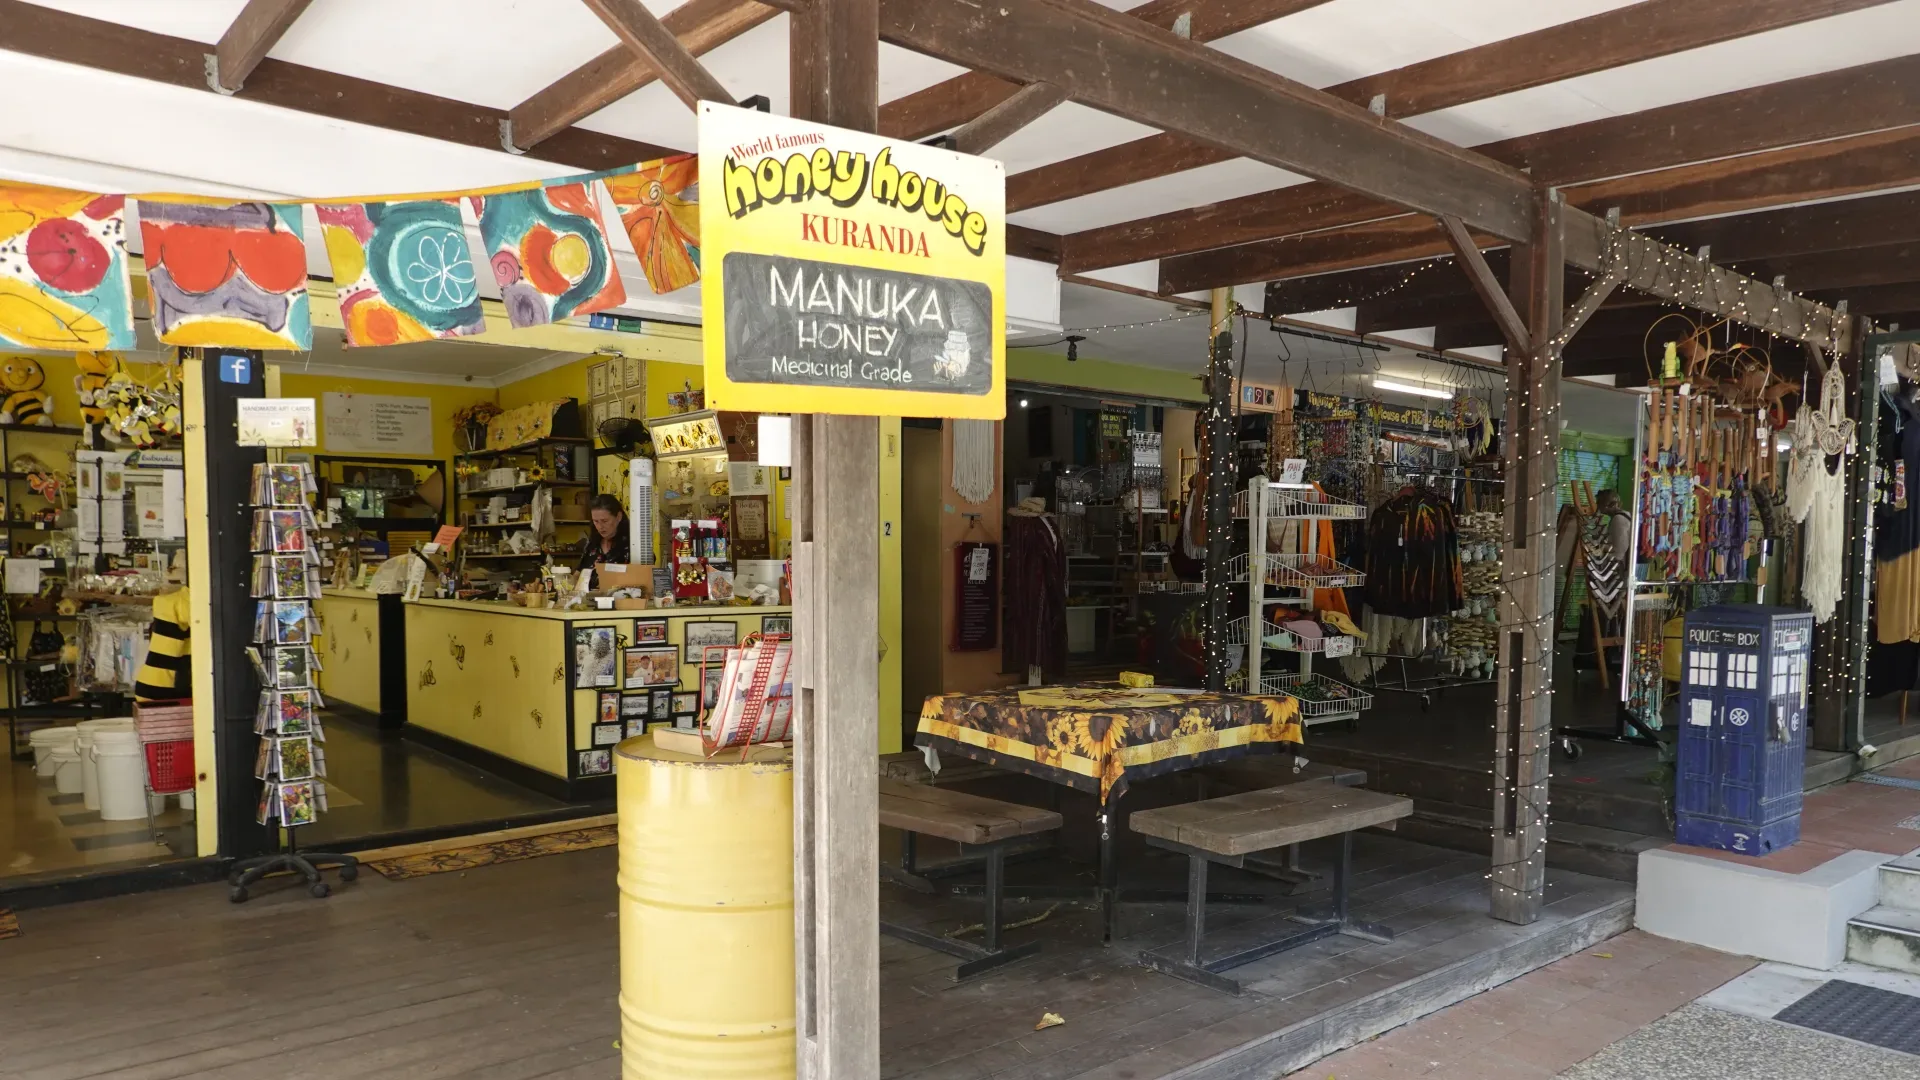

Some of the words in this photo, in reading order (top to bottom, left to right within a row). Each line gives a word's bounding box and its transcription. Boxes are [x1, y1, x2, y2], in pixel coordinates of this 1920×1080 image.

[731, 139, 774, 162] World
[774, 132, 826, 150] famous
[723, 147, 870, 220] honey
[871, 146, 988, 257] house
[801, 212, 931, 258] KURANDA
[769, 264, 945, 330] MANUKA
[798, 319, 899, 357] HONEY
[771, 355, 853, 379] Medicinal
[861, 358, 913, 383] Grade
[1286, 462, 1303, 472] FANS
[885, 522, 891, 536] 2
[1689, 629, 1720, 643] POLICE
[1737, 633, 1760, 646] BOX
